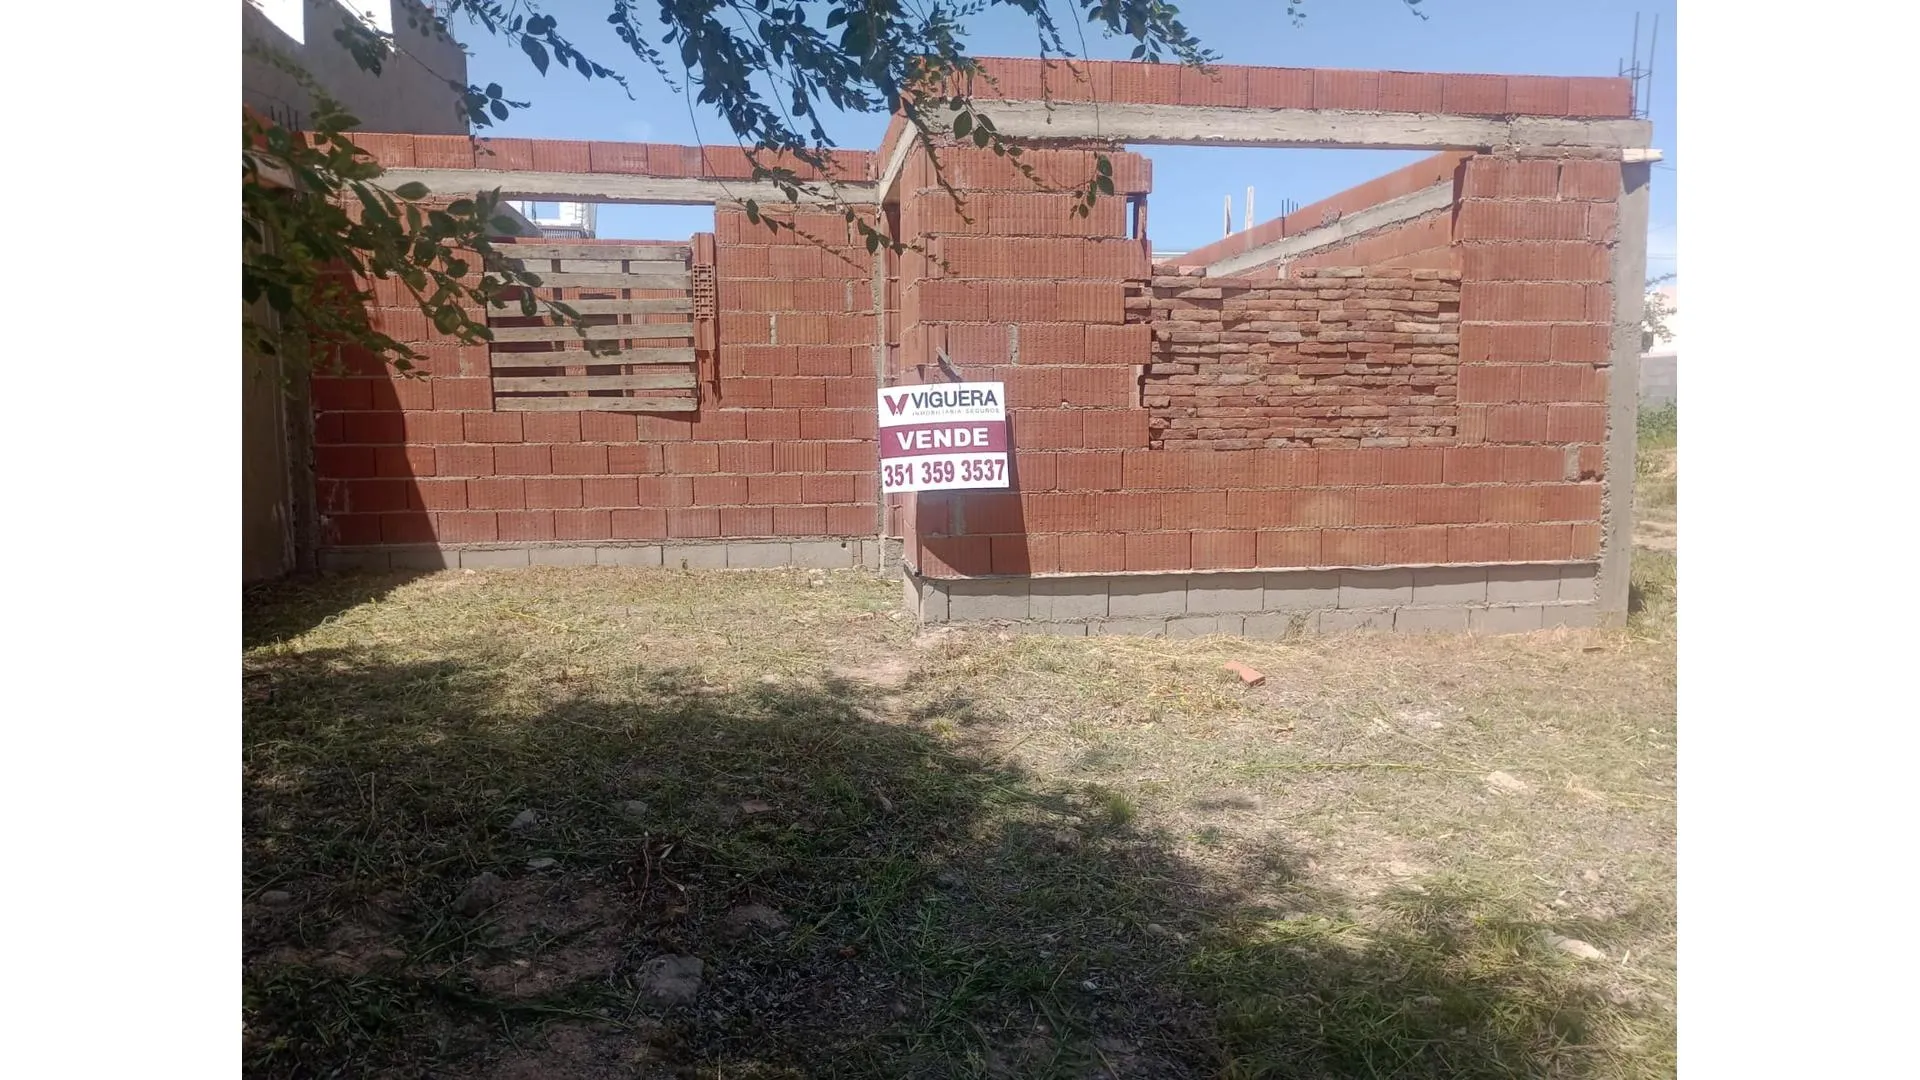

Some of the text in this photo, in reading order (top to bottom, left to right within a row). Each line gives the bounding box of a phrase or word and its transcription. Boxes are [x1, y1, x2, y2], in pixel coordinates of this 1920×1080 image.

[911, 389, 998, 409] VIGUERA
[896, 427, 989, 450] VENDE
[884, 458, 1005, 487] 351 359 3537
